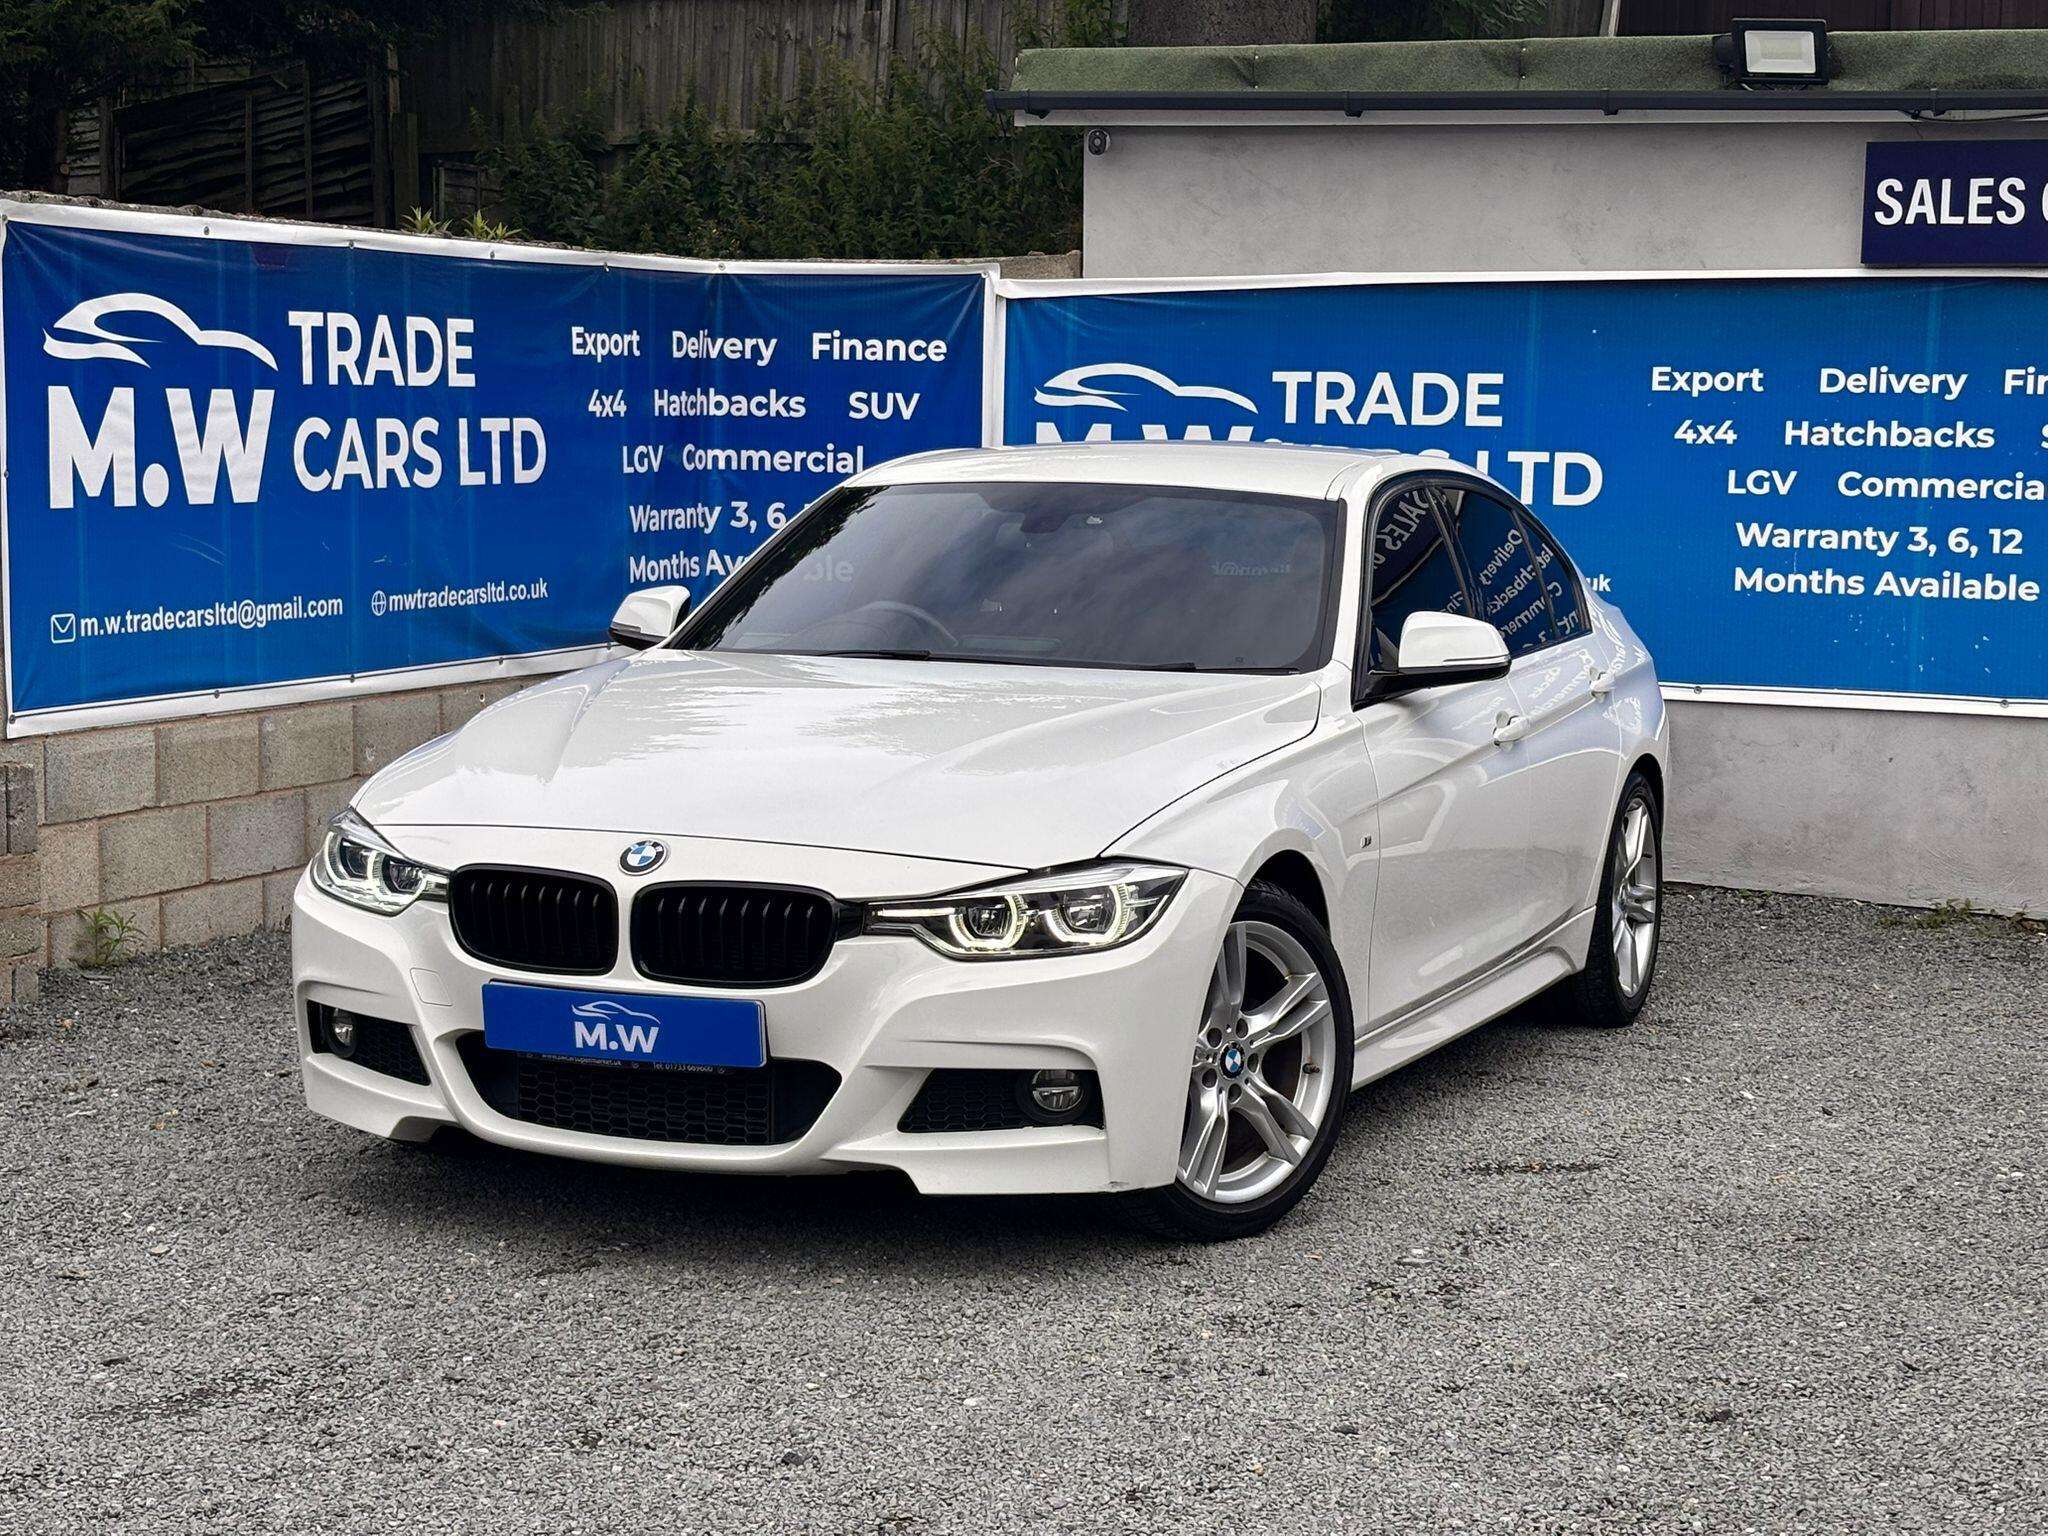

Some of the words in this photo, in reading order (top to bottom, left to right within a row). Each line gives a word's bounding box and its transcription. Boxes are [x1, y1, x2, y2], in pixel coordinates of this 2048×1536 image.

[1875, 178, 2025, 225] SALES
[288, 311, 475, 387] TRADE
[572, 327, 640, 362] Export
[673, 329, 777, 366] Delivery
[813, 330, 947, 361] Finance
[1272, 372, 1503, 426] TRADE
[1652, 367, 1763, 397] Export
[1820, 366, 1967, 400] Delivery
[589, 390, 626, 417] 4x4
[655, 388, 806, 417] Hatchbacks
[849, 392, 920, 419] SUV
[48, 386, 274, 508] M.W
[1675, 420, 1737, 444] 4x4
[1785, 420, 1994, 448] Hatchbacks
[294, 417, 442, 491] CARS
[459, 418, 546, 485] LTD
[623, 446, 663, 473] LGV
[683, 443, 864, 474] Commercial
[1728, 470, 1797, 494] LGV
[1838, 471, 2044, 500] Commercia
[630, 503, 721, 534] Warranty
[730, 502, 756, 533] 3,
[766, 502, 787, 529] 6
[1736, 523, 1899, 557] Warranty
[1908, 527, 1936, 557] 3,
[1948, 528, 1978, 558] 6,
[1989, 529, 2022, 554] 12
[630, 551, 699, 586] Months
[1735, 567, 1864, 595] Months
[1874, 571, 2039, 601] Available
[390, 578, 547, 611] mwtradecarsltd.co.uk
[81, 596, 342, 636] m.w.tradecarsltd@gmail.com
[575, 1020, 660, 1052] M.W
